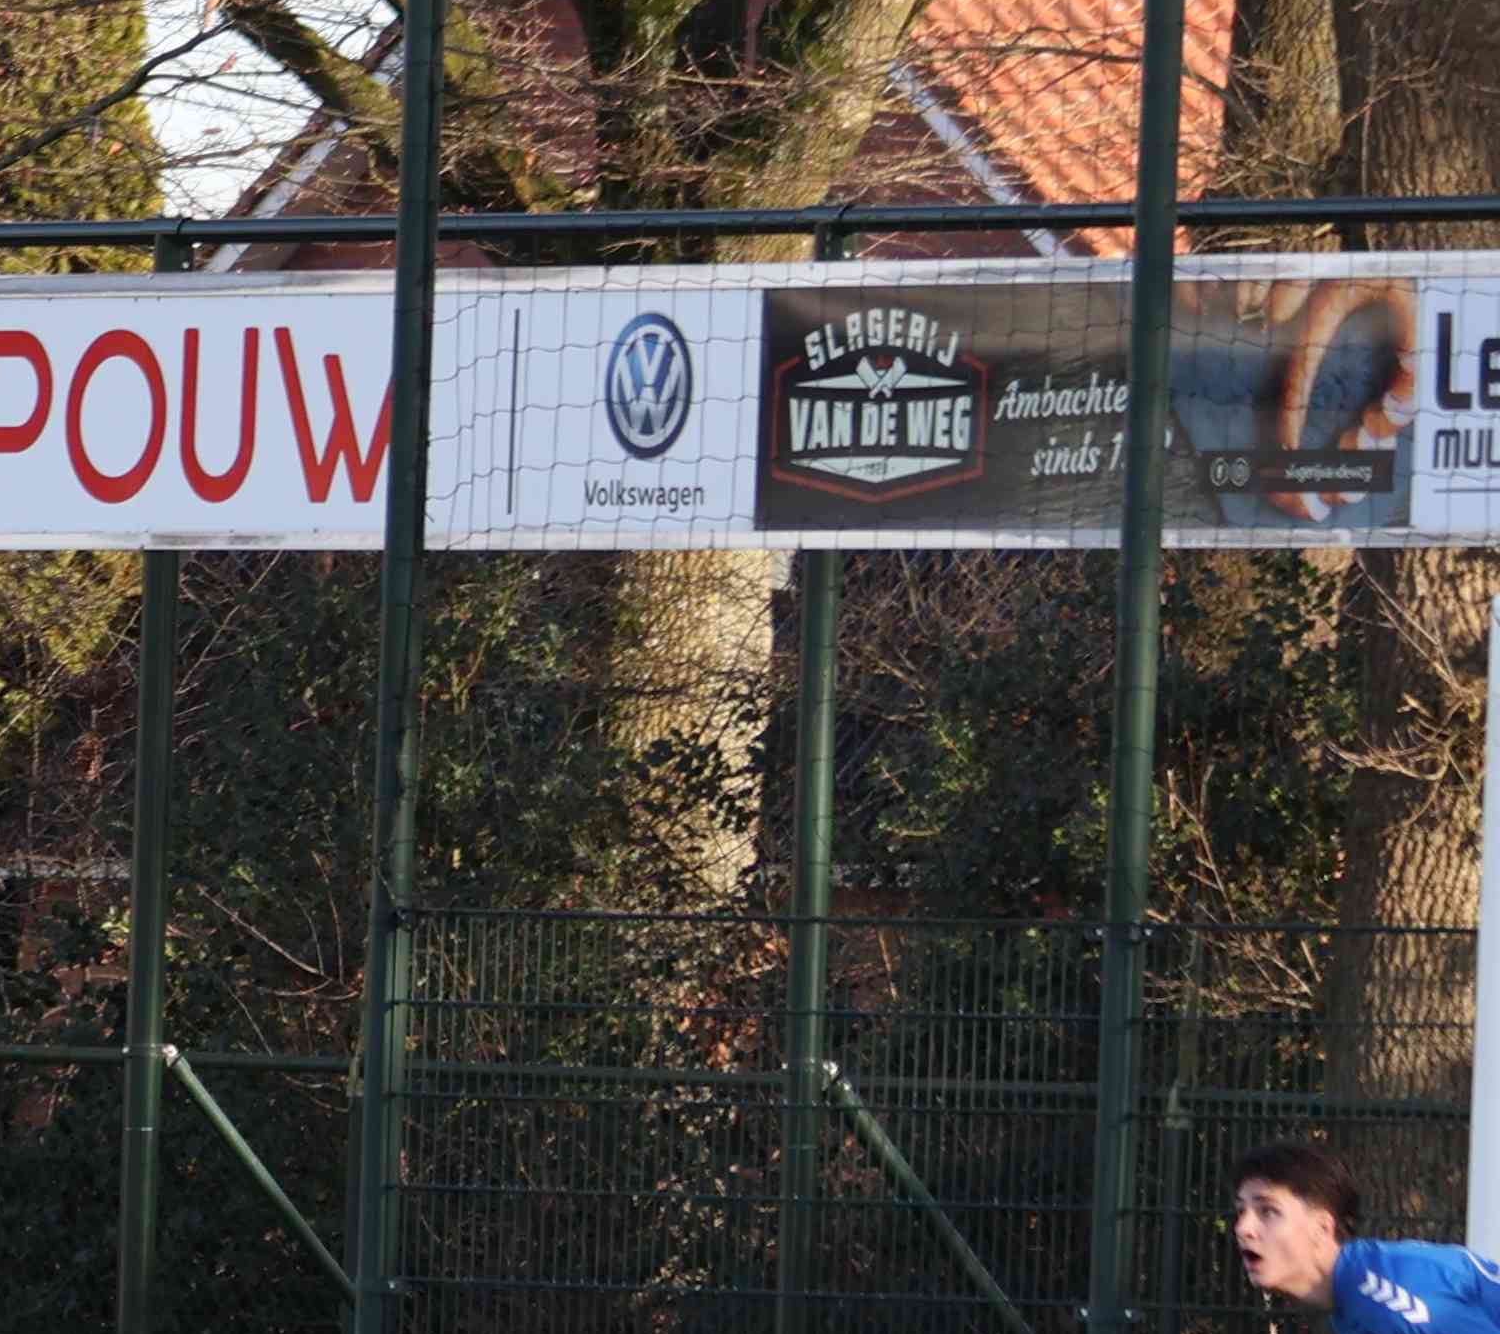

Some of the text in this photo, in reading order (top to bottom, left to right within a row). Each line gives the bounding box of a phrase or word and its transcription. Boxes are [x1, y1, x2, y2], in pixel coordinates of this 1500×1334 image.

[803, 307, 960, 371] SLAGERIJ
[994, 372, 1130, 421] Ambachte
[788, 395, 972, 452] VAN DE WEG
[1031, 430, 1100, 476] sinds
[584, 479, 705, 513] Volkswagen
